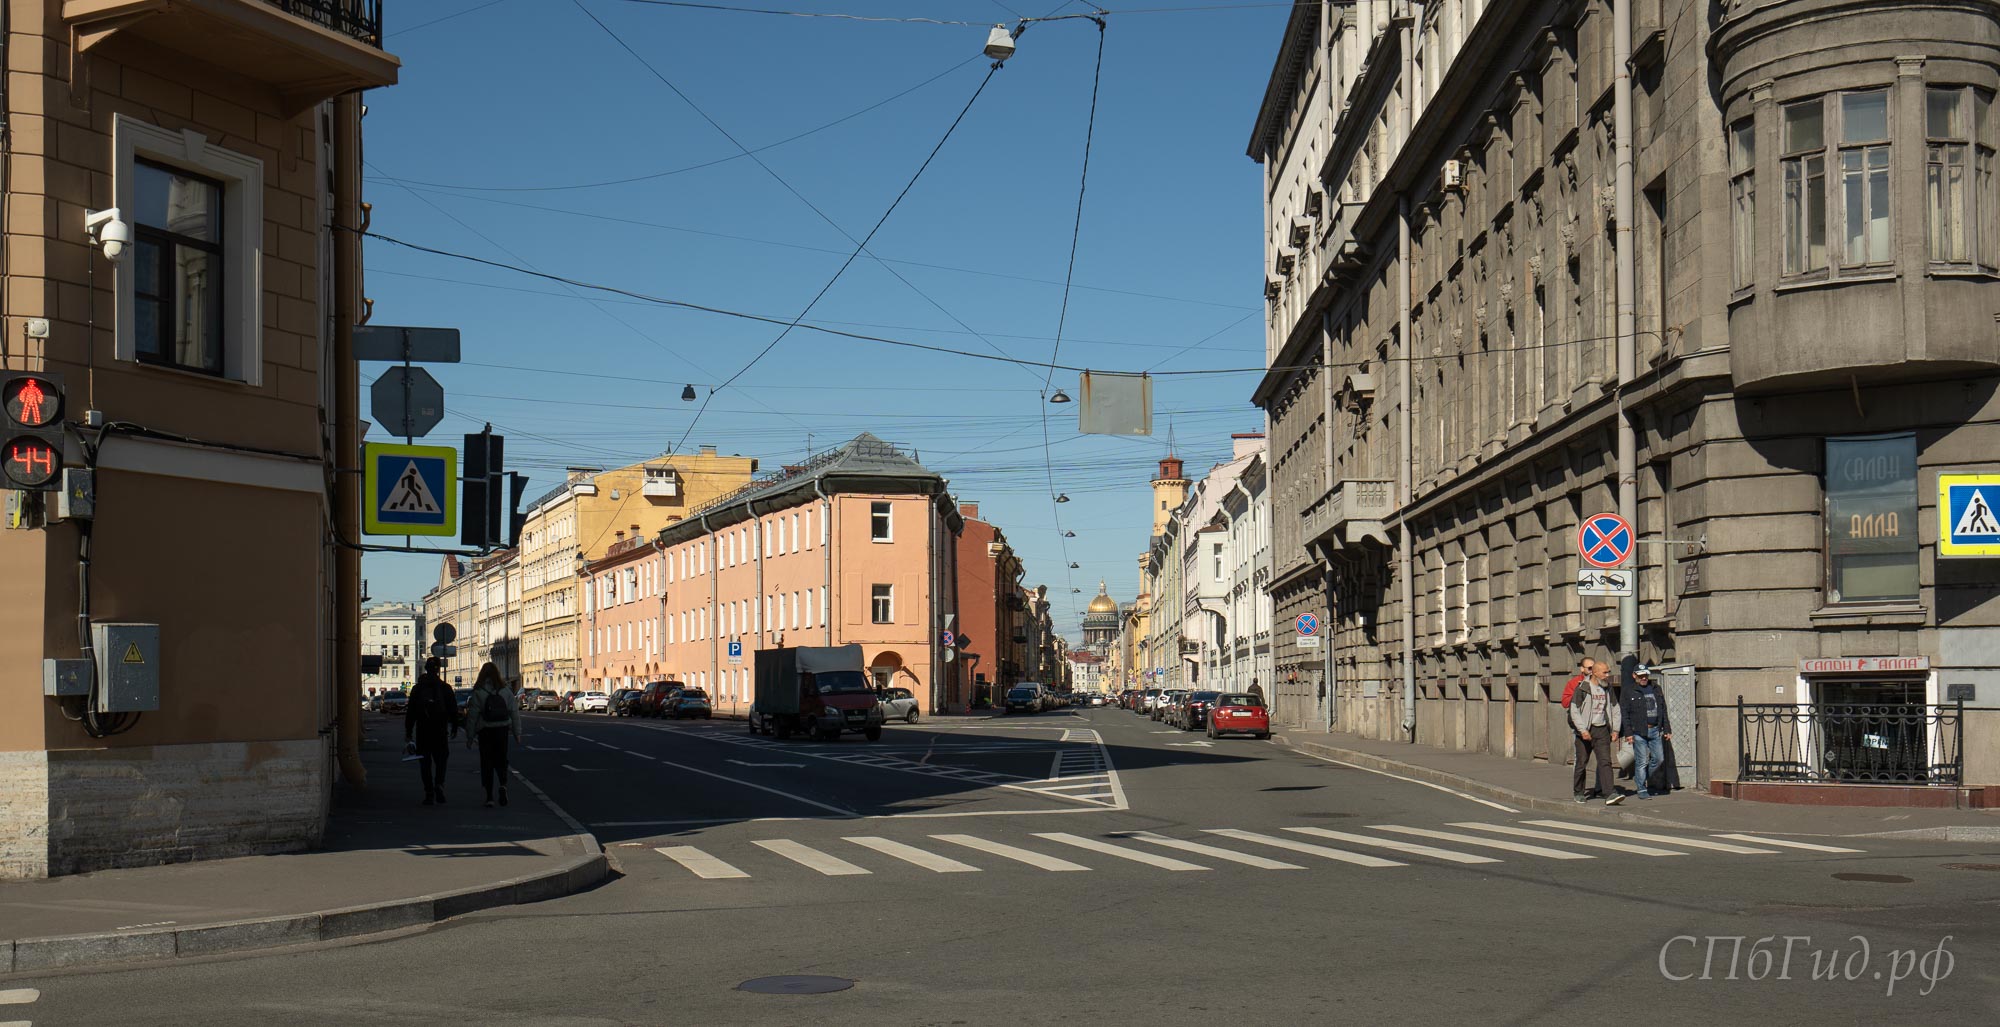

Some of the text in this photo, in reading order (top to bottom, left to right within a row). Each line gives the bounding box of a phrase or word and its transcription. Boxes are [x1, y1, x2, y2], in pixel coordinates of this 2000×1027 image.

[13, 447, 51, 474] 44
[1844, 455, 1900, 482] САЛОН
[1849, 511, 1899, 539] АЛЛА
[732, 643, 740, 655] P
[1805, 656, 1923, 672] САЛОН "АЛЛА"
